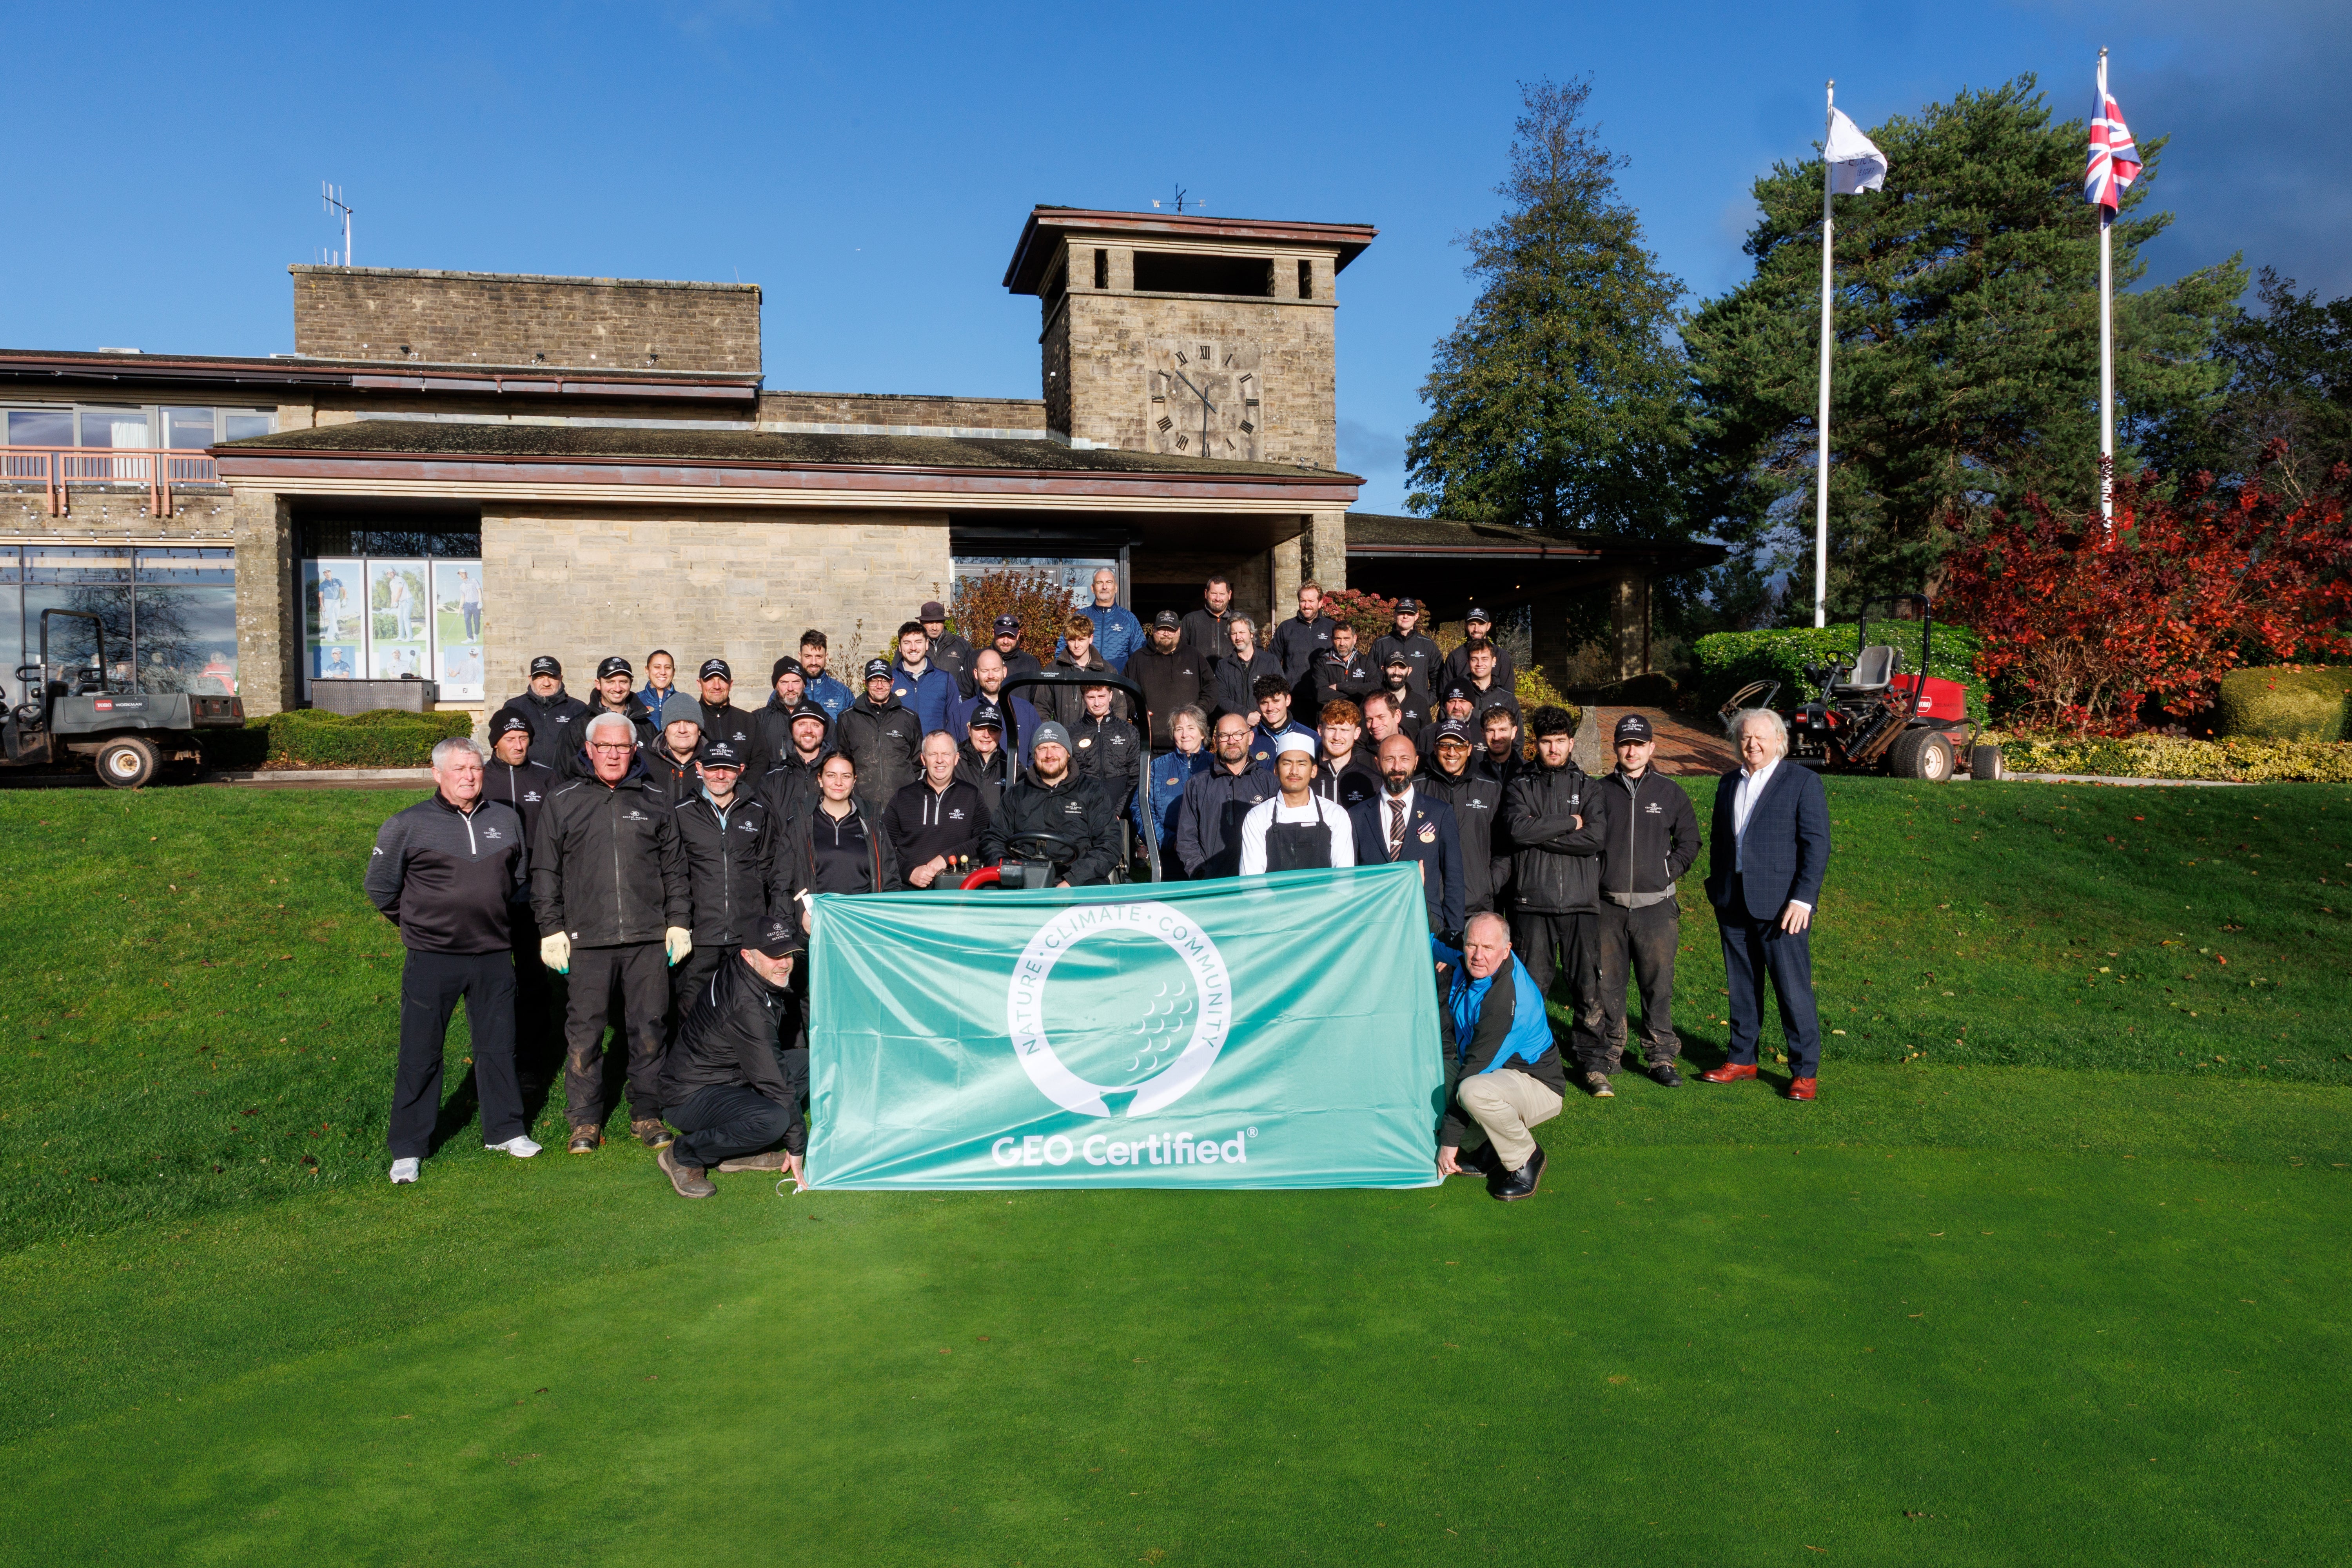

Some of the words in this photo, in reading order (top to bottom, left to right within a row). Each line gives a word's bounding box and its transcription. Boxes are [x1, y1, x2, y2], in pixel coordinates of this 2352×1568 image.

[1200, 346, 1210, 359] XII
[1239, 372, 1253, 383] II
[1016, 960, 1042, 1056] NATURE
[1045, 905, 1142, 948] CLIMATE
[1159, 916, 1223, 1048] COMMUNITY
[991, 1134, 1074, 1167] GEO
